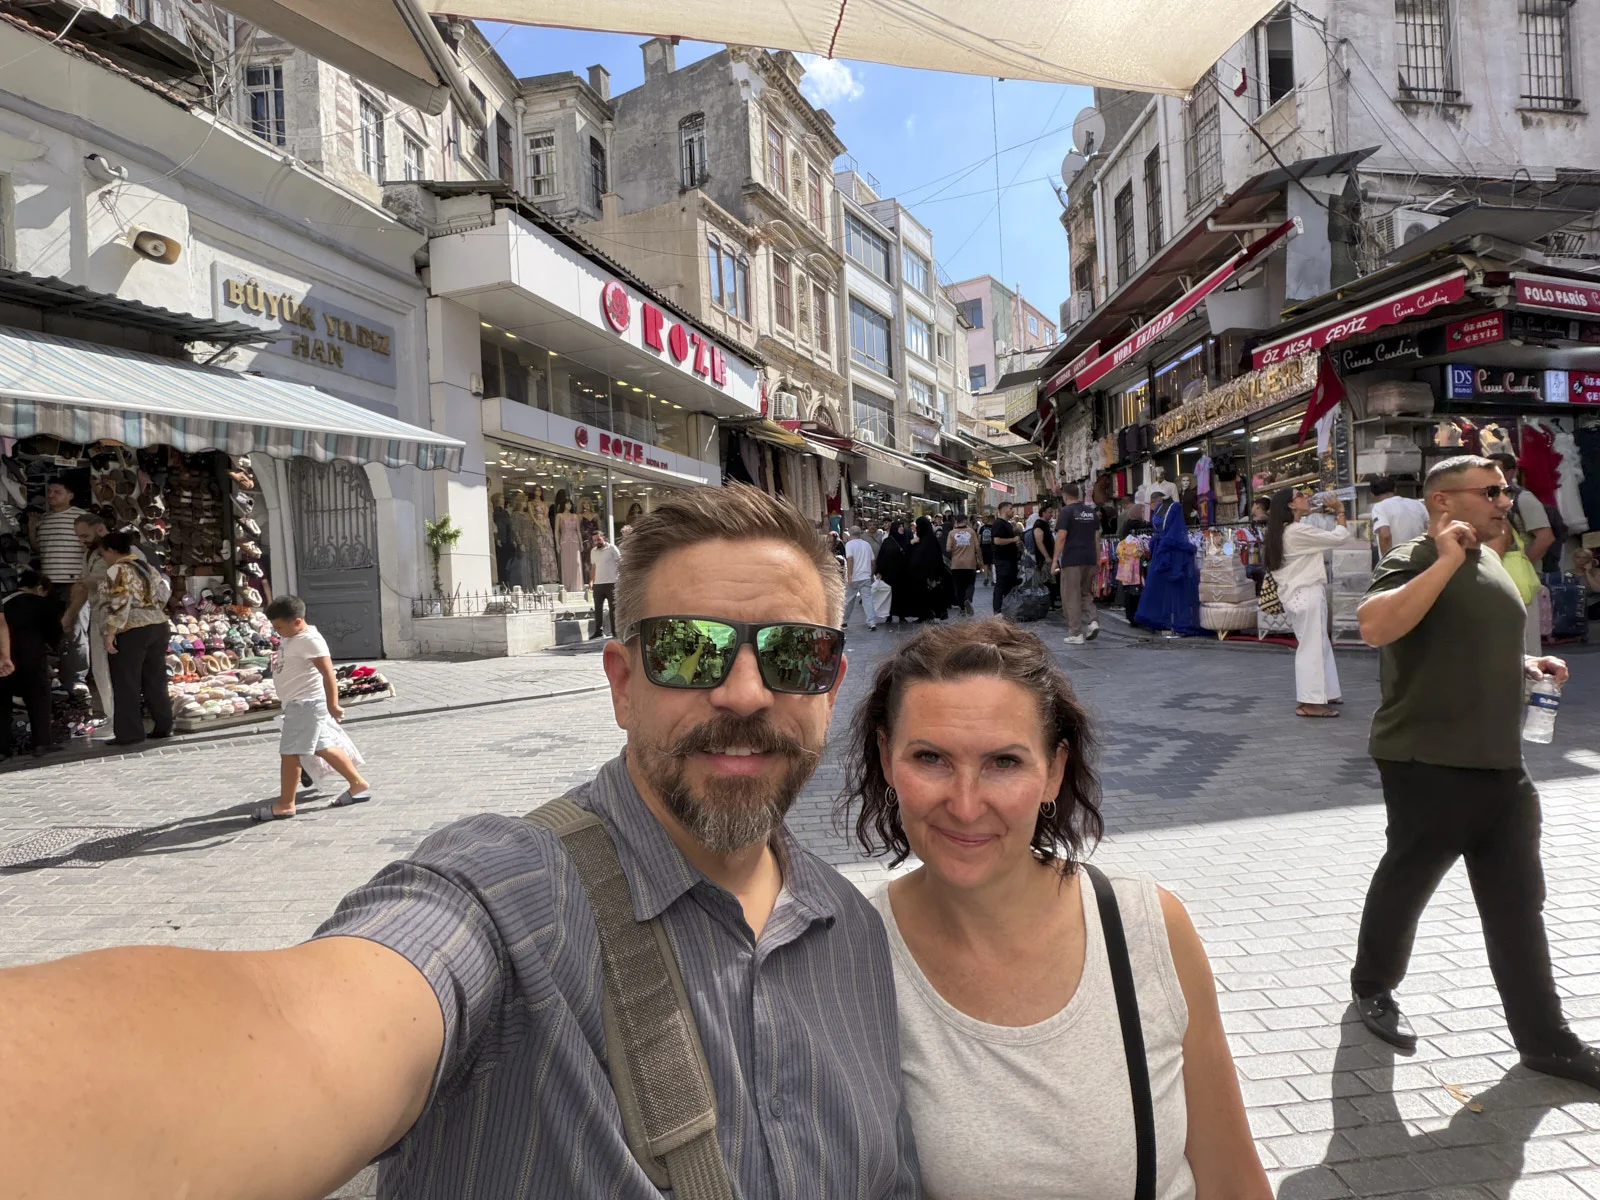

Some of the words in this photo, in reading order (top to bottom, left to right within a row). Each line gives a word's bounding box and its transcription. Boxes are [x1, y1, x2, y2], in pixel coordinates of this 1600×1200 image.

[1524, 286, 1554, 302] POLO
[1555, 290, 1588, 307] PARİS
[226, 278, 316, 331] BÜYÜK
[323, 312, 391, 356] YILDIZ
[1463, 323, 1475, 332] ÖZ
[1476, 317, 1499, 329] AKSA
[291, 331, 344, 369] HAN
[642, 302, 727, 386] ROZE
[1262, 349, 1280, 364] ÖZ
[1283, 337, 1312, 357] AKSA
[1325, 317, 1367, 344] ÇEYİZ
[1586, 391, 1600, 402] ÇE
[600, 433, 644, 462] ROZE
